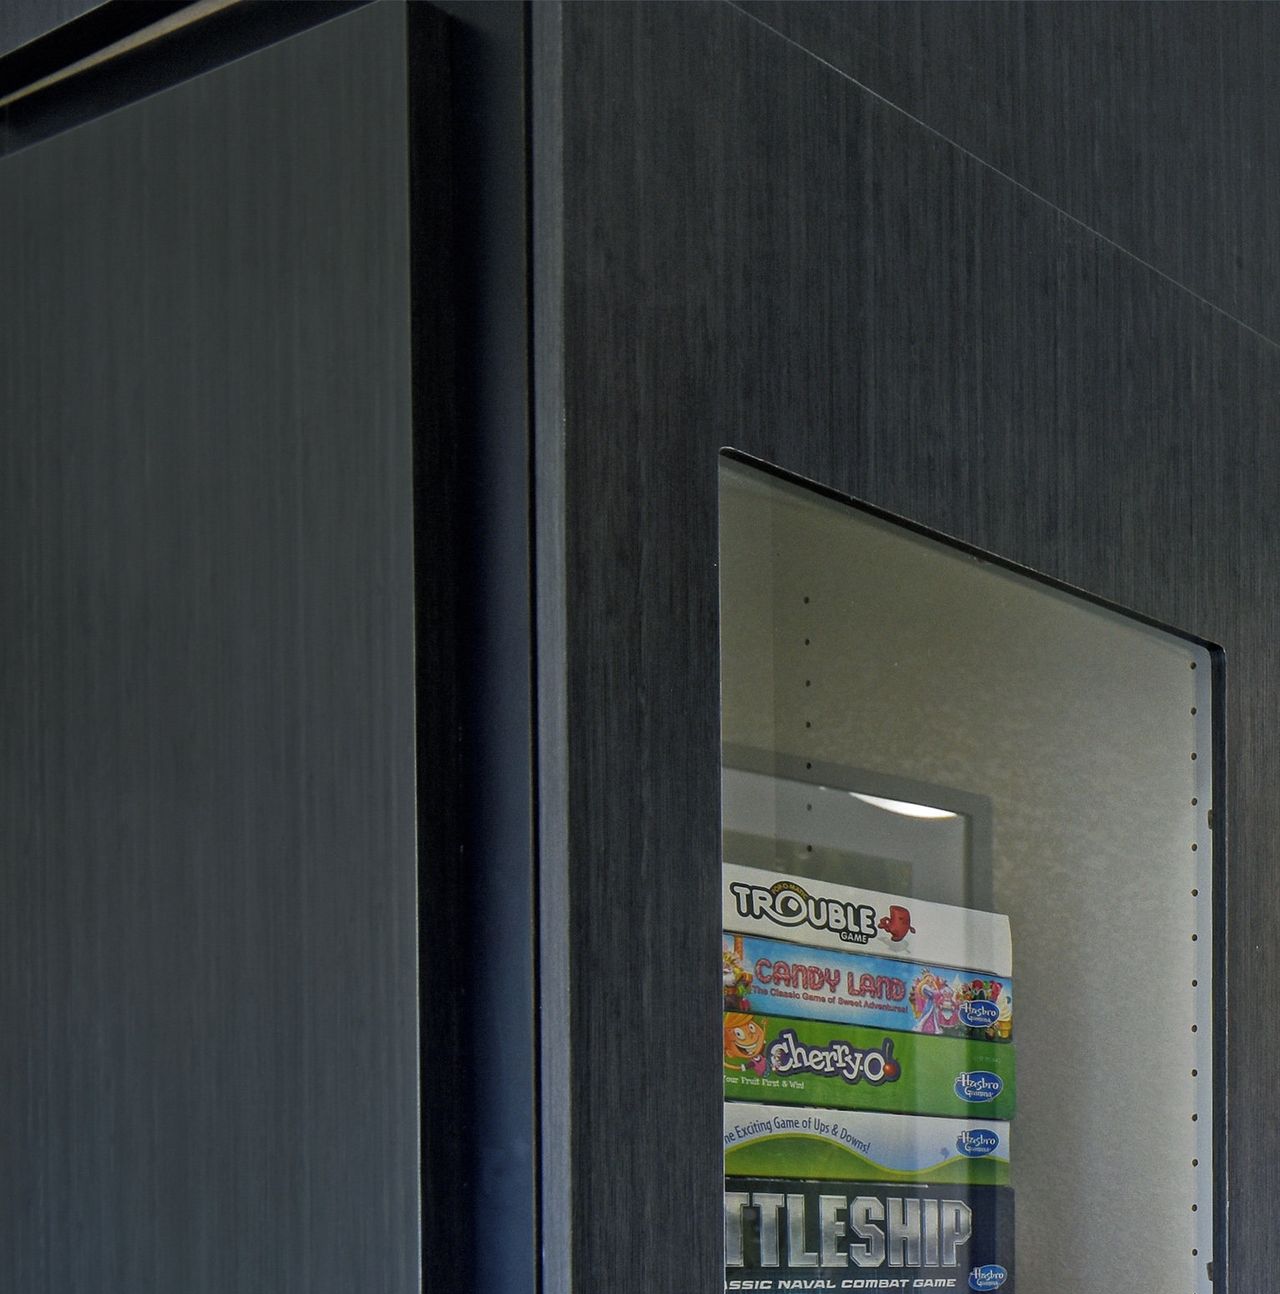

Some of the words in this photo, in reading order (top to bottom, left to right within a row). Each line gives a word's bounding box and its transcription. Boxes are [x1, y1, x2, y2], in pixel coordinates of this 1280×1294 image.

[732, 884, 876, 936] TROUBLE
[840, 932, 868, 944] GAME
[754, 957, 841, 993] CANDY
[847, 971, 907, 1001] LAND
[752, 985, 769, 995] The
[770, 988, 801, 1000] Classic
[802, 992, 826, 1004] Game
[828, 996, 837, 1004] of
[838, 998, 862, 1009] Sweet
[960, 1002, 997, 1017] Hasbro
[957, 1073, 999, 1091] Hasbro
[735, 1119, 773, 1139] Exciting
[773, 1116, 800, 1130] Game
[801, 1117, 812, 1129] of
[813, 1117, 830, 1134] Ups
[831, 1123, 839, 1137] &
[840, 1127, 872, 1155] Downs!
[959, 1131, 996, 1147] Hasbro
[970, 1266, 1004, 1281] Hasbro
[725, 1280, 773, 1290] SSIC
[778, 1279, 837, 1290] NAVAL
[841, 1279, 910, 1290] COMBAT
[913, 1278, 957, 1288] GAME
